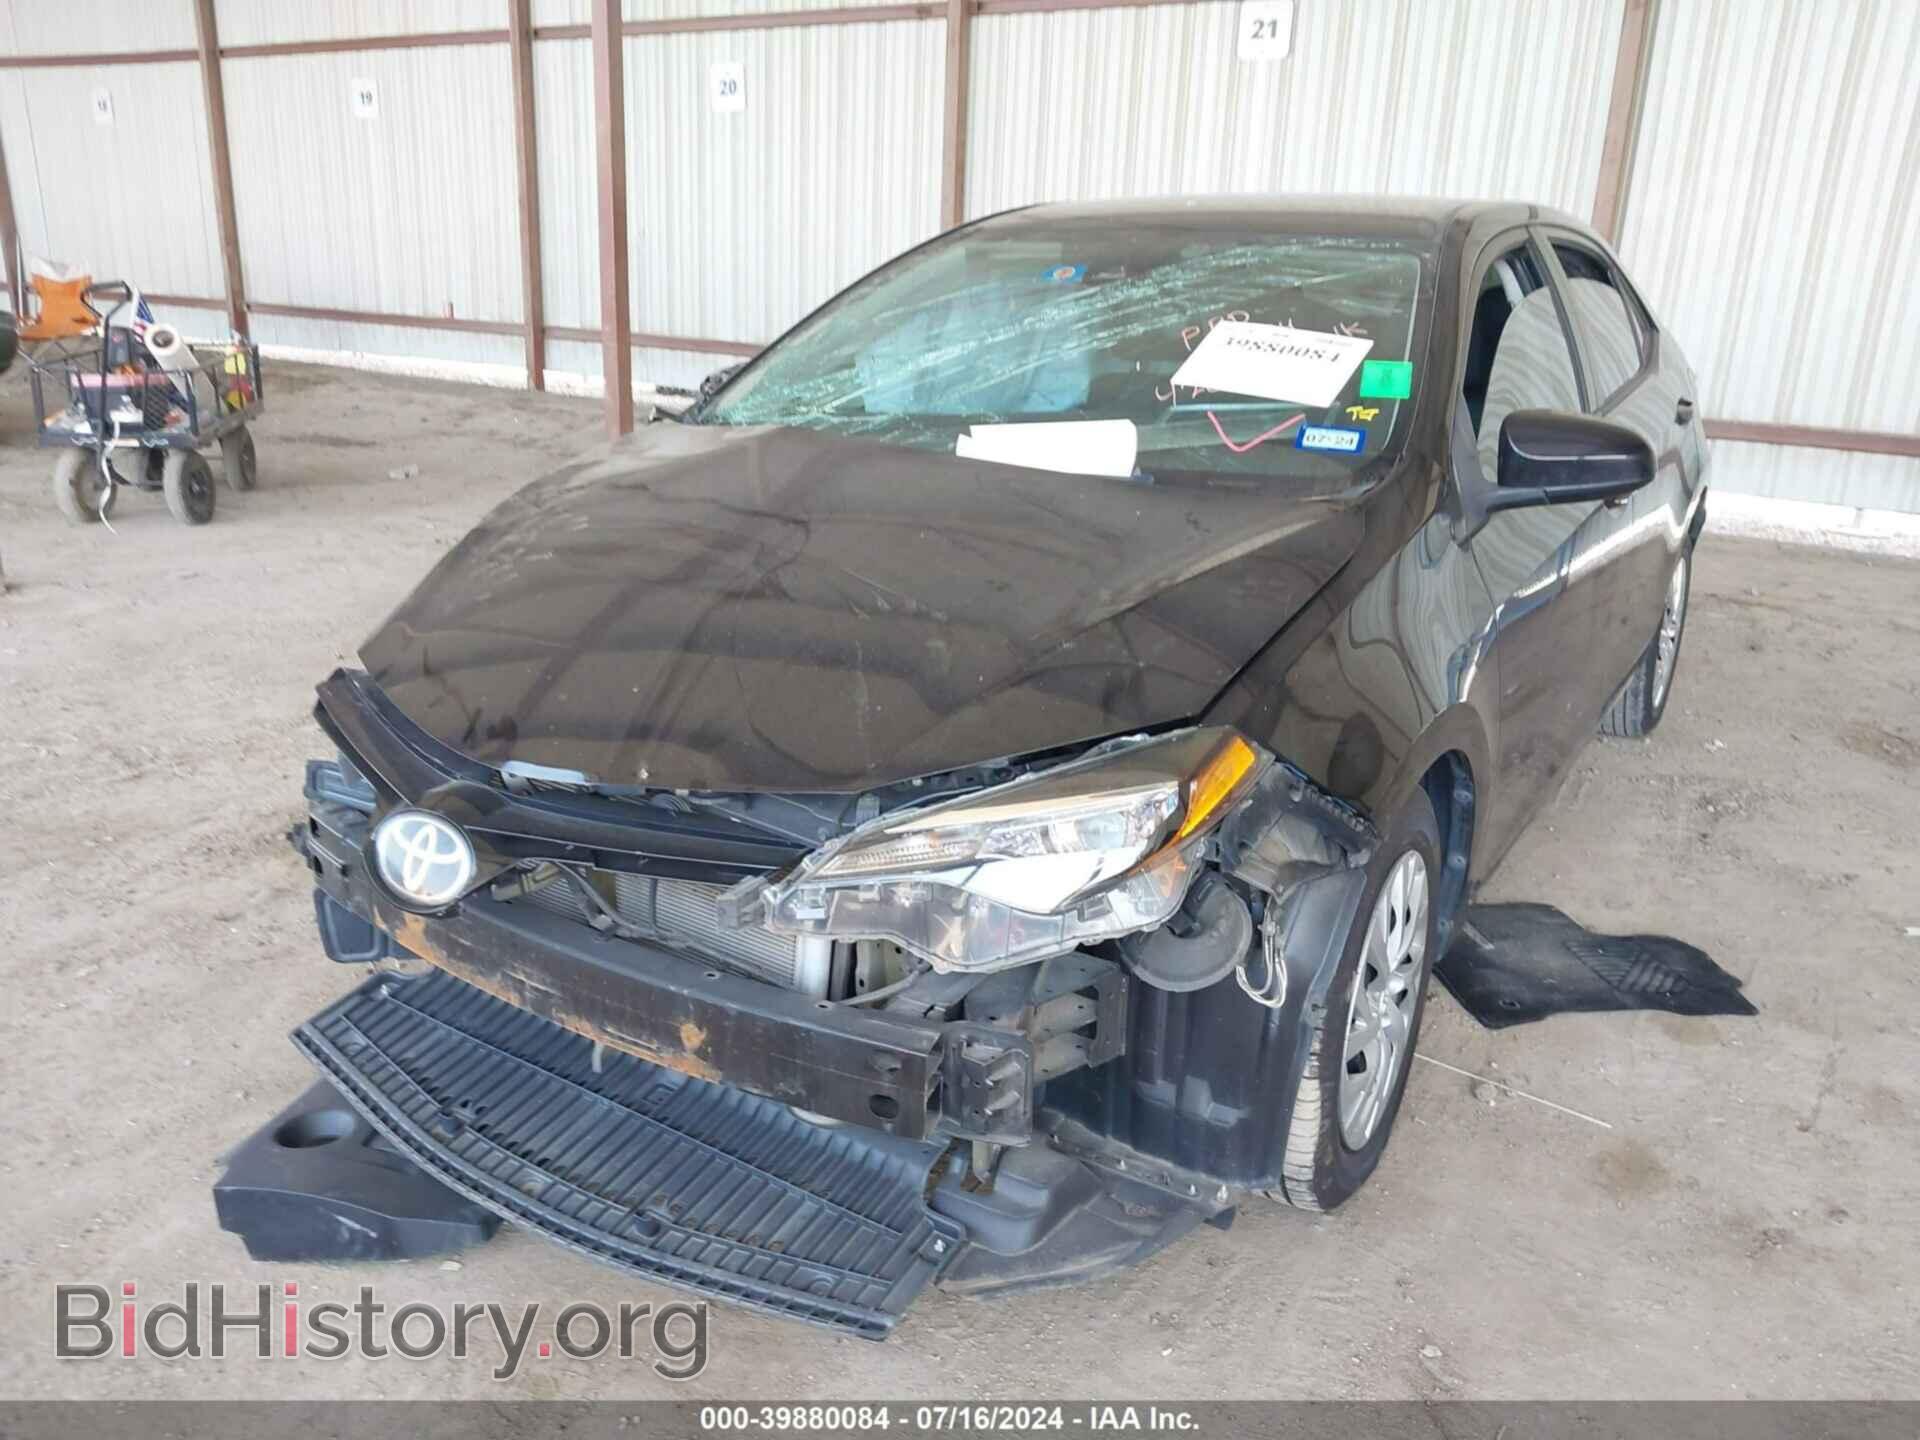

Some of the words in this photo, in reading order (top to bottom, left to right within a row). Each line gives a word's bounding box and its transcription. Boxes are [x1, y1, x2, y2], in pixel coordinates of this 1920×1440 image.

[1250, 18, 1278, 39] 21
[719, 79, 737, 97] 20
[360, 90, 373, 106] 19
